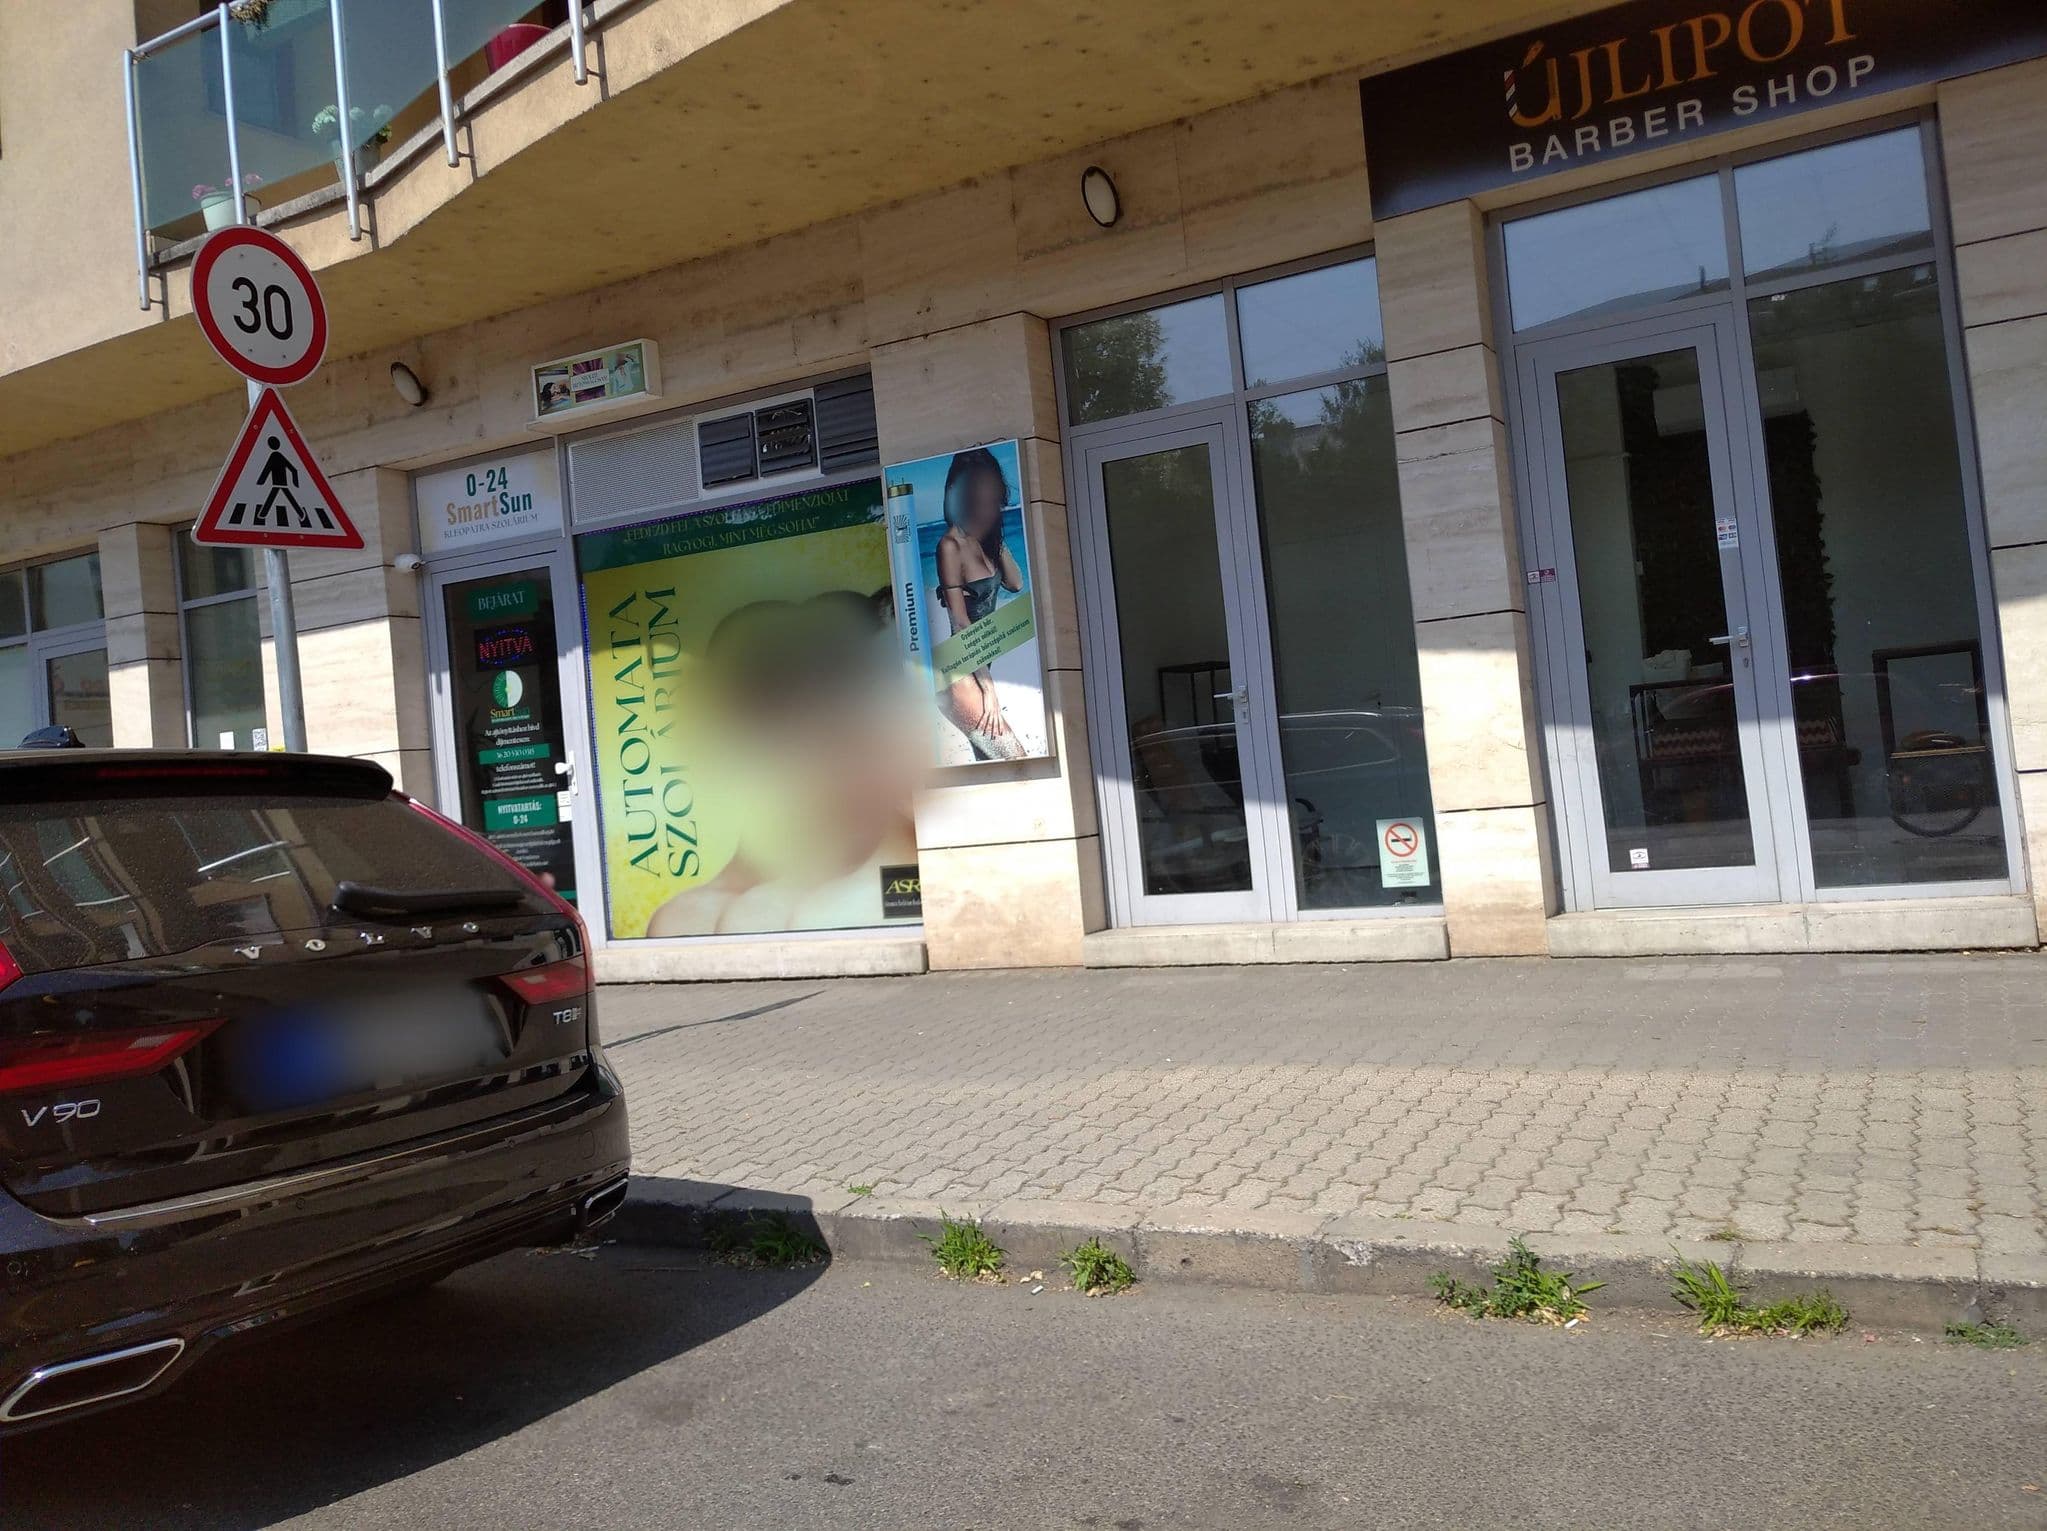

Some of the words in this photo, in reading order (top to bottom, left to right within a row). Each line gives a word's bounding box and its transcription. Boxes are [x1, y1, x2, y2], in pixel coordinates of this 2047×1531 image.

[1509, 98, 1705, 173] BARBER
[1732, 54, 1876, 116] SHOP
[231, 276, 294, 341] 30
[466, 466, 509, 497] 0-24
[446, 491, 533, 525] SmartSun
[477, 590, 526, 611] BEJÁRAT
[904, 582, 920, 652] Premium
[479, 636, 534, 659] NYITVA
[608, 591, 661, 878] AUTOMATA
[234, 920, 480, 960] VOLVO
[20, 1098, 101, 1127] V90
